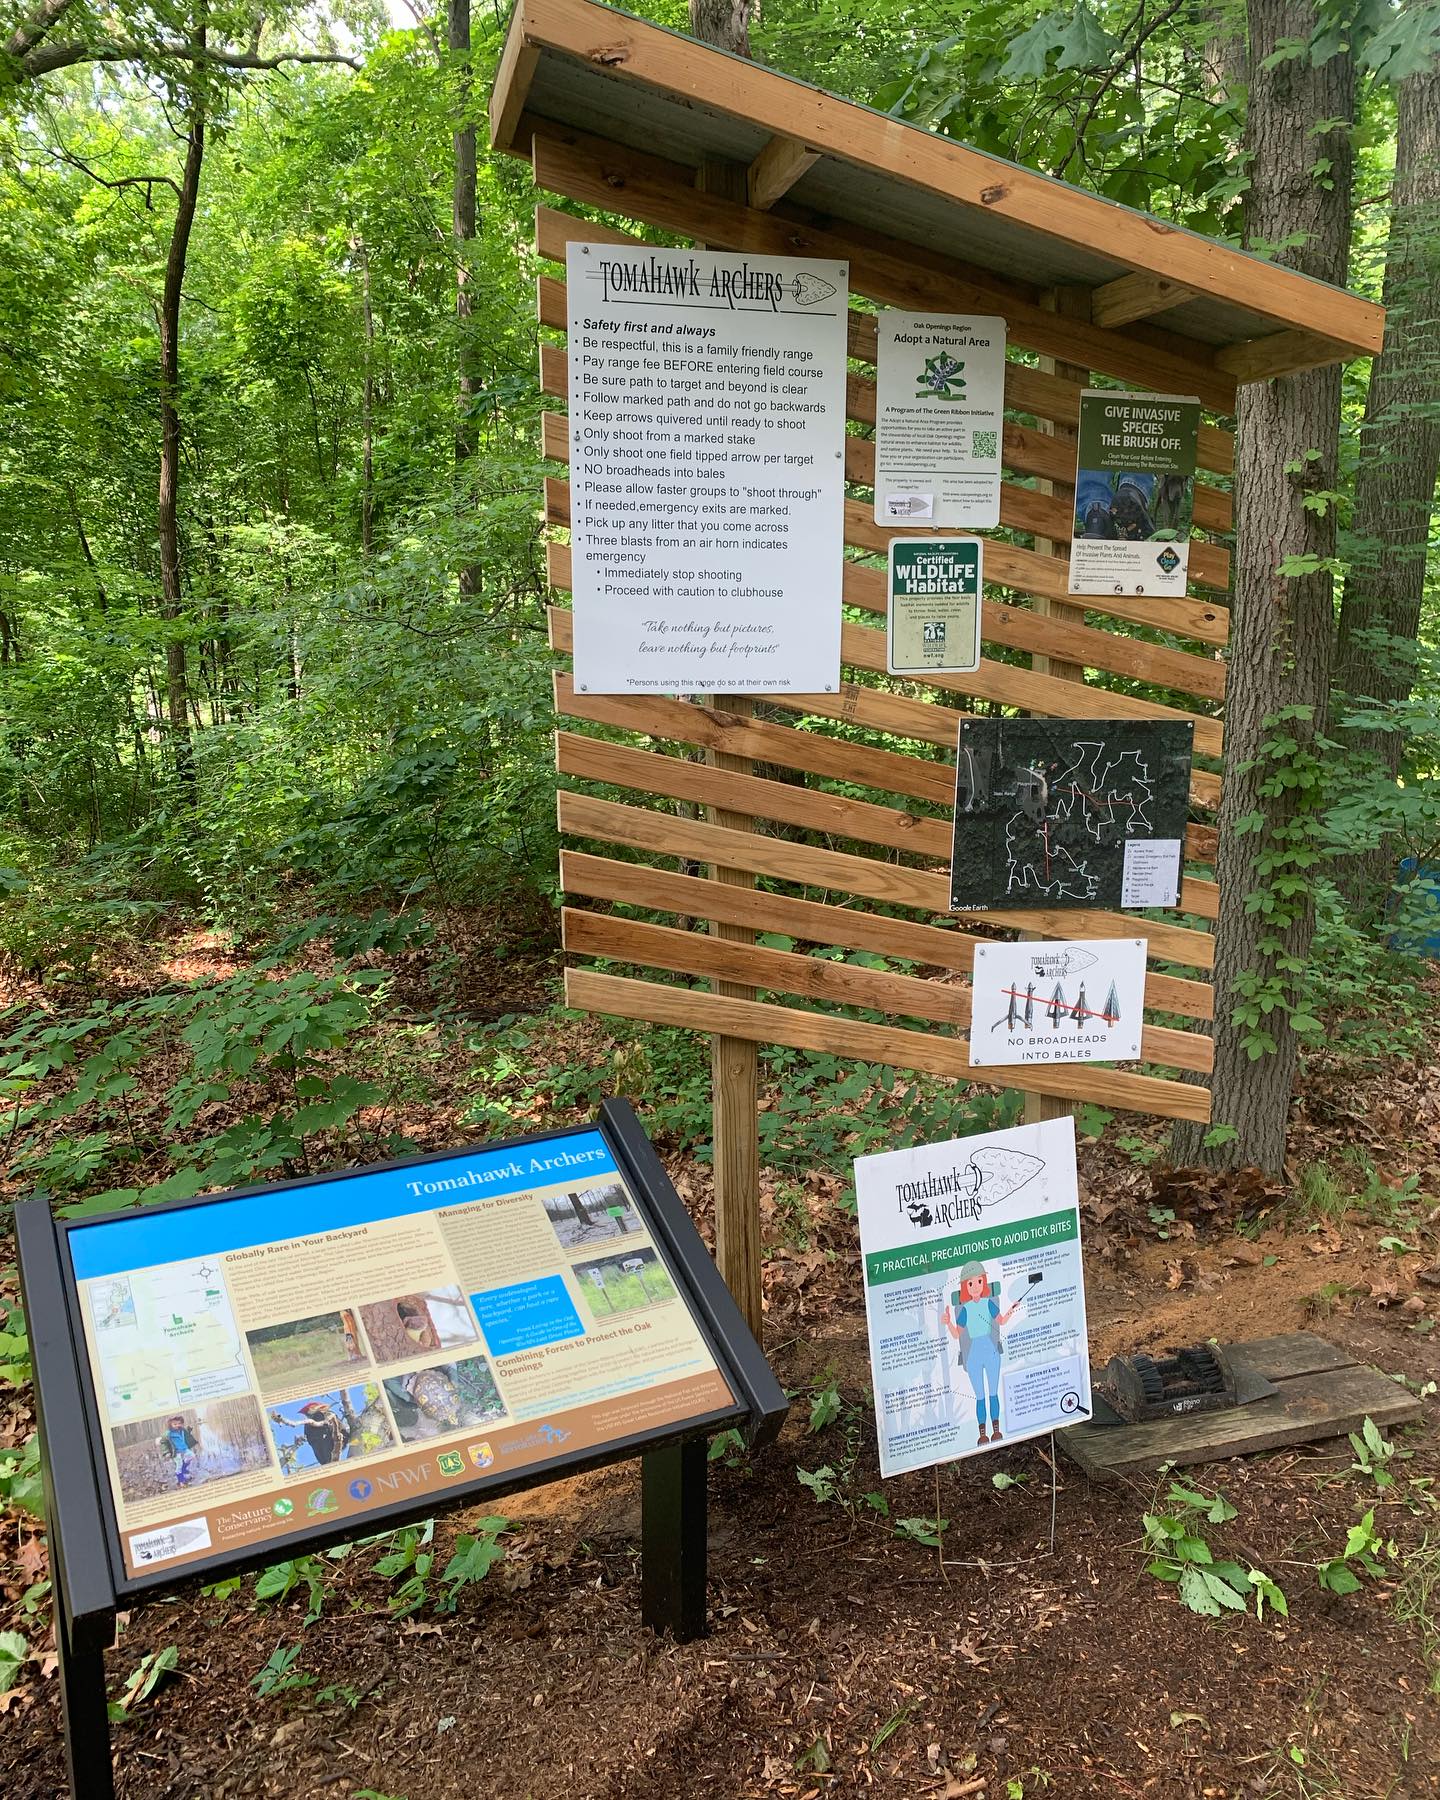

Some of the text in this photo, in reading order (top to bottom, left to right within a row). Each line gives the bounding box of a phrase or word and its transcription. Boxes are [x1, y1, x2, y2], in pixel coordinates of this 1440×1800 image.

[600, 256, 784, 313] TOMAHAWK ARCHERS
[582, 318, 715, 338] Safety first and always
[925, 323, 951, 331] Openings
[952, 324, 971, 332] Region
[893, 333, 922, 345] Adopt
[932, 335, 966, 345] Natural
[968, 337, 989, 346] Area
[582, 336, 813, 362] Be respectful, this is a family friendly range
[583, 354, 823, 378] Pay range fee BEFORE entering field course
[890, 406, 914, 414] Program
[1104, 405, 1180, 421] GIVE INVASIVE
[583, 427, 755, 445] Only shoot from a marked stake
[1122, 421, 1163, 434] SPECIES
[1100, 433, 1181, 450] THE BRUSH OFF.
[584, 463, 725, 478] NO broadheads into bales
[584, 481, 821, 501] Please allow faster groups to "shoot through"
[585, 498, 791, 515] If needed,emergency exits are marked.
[585, 534, 787, 549] Three blasts from an air horn indicates
[585, 552, 646, 564] emergency
[916, 556, 954, 565] Certified
[896, 564, 976, 580] WILDLIFE
[604, 584, 783, 597] Proceed with caution to clubhouse
[906, 578, 966, 594] Habitat
[641, 620, 669, 634] "Take
[670, 620, 711, 638] nothing
[713, 620, 731, 634] but
[638, 640, 665, 652] leave
[667, 641, 706, 658] nothing
[709, 641, 727, 654] but
[660, 679, 679, 687] using
[716, 679, 726, 687] do
[1007, 1034, 1106, 1045] NO BROADHEADS
[1022, 1049, 1091, 1060] INTO BALES
[406, 1148, 605, 1196] Tomahawk Archers
[895, 1167, 963, 1213] TOMAHAWK
[438, 1194, 534, 1219] Managing for Diversity
[934, 1195, 984, 1228] ARCHERS
[225, 1249, 264, 1262] Globally
[266, 1245, 289, 1254] Rare
[301, 1238, 323, 1246] Your
[325, 1227, 368, 1241] Backyard
[873, 1220, 1071, 1274] 7 PRACTICAL PRECAUTIONS TO AVOID TICK BITES
[495, 1351, 544, 1369] Combining
[545, 1341, 575, 1357] Forces
[575, 1339, 586, 1348] to
[586, 1330, 618, 1345] Protect
[619, 1325, 635, 1337] the
[634, 1321, 653, 1333] Oak
[500, 1361, 544, 1378] Openings
[376, 1462, 432, 1493] NFWF
[216, 1506, 273, 1527] The Nature
[217, 1513, 273, 1534] Conservancy
